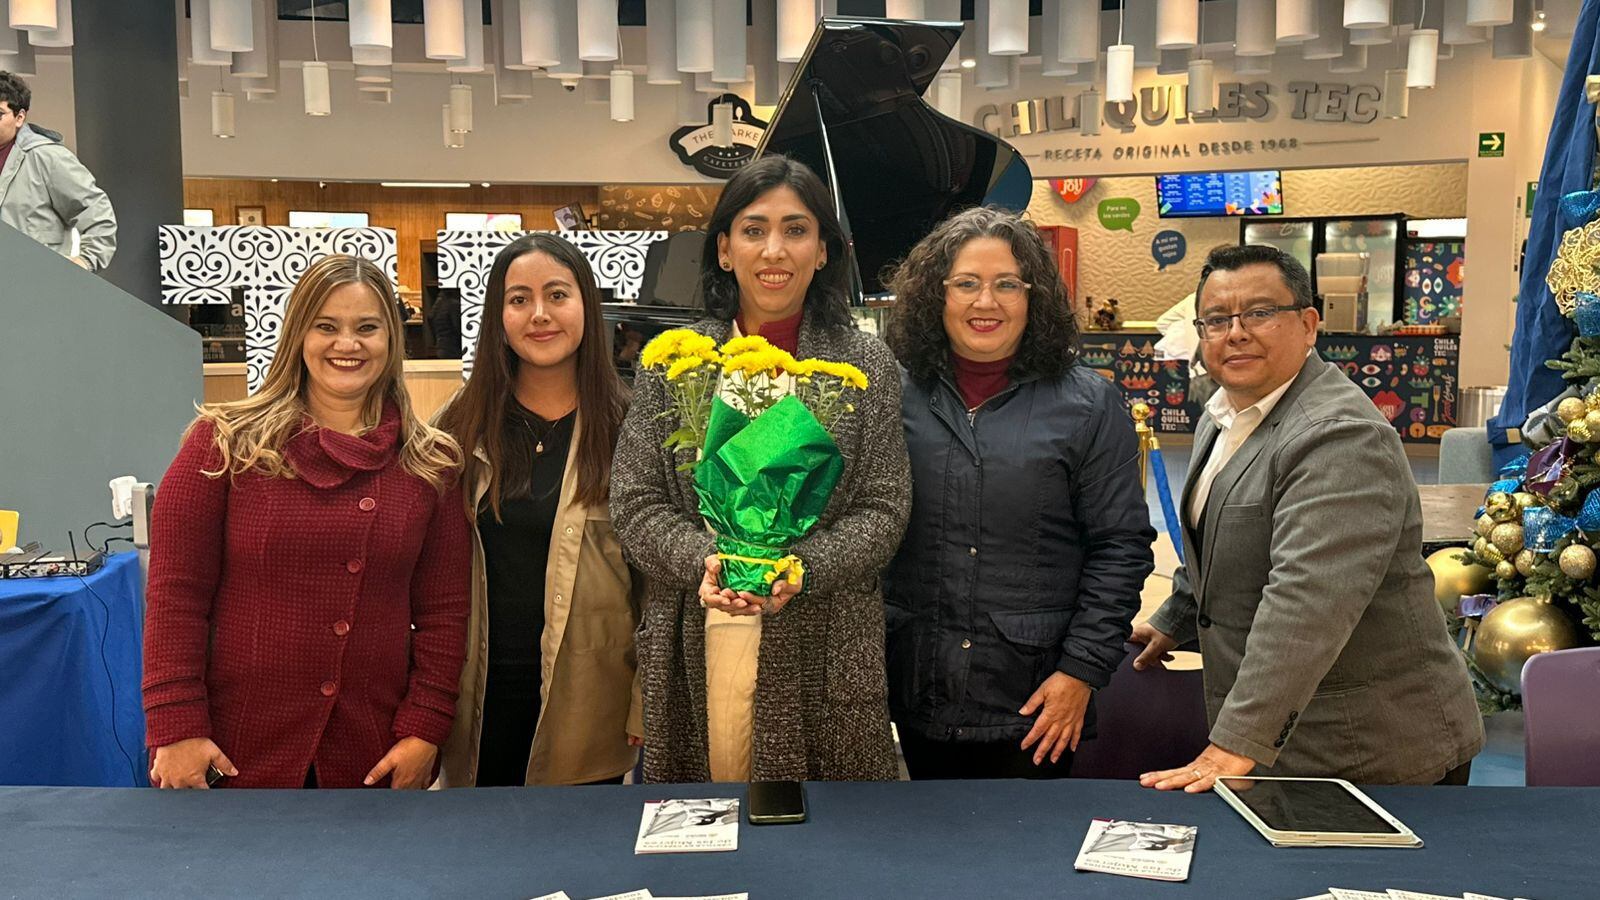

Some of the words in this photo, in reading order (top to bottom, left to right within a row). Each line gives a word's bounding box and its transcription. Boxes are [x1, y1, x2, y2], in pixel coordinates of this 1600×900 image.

[1288, 81, 1381, 123] TEC
[692, 130, 714, 144] THE
[1045, 147, 1102, 160] RECETA
[1113, 143, 1190, 161] ORIGINAL
[1199, 139, 1254, 155] DESDE
[1260, 137, 1298, 151] 1968
[1161, 408, 1186, 416] CHILA
[1160, 416, 1190, 424] QUILES
[1161, 423, 1176, 431] TEC
